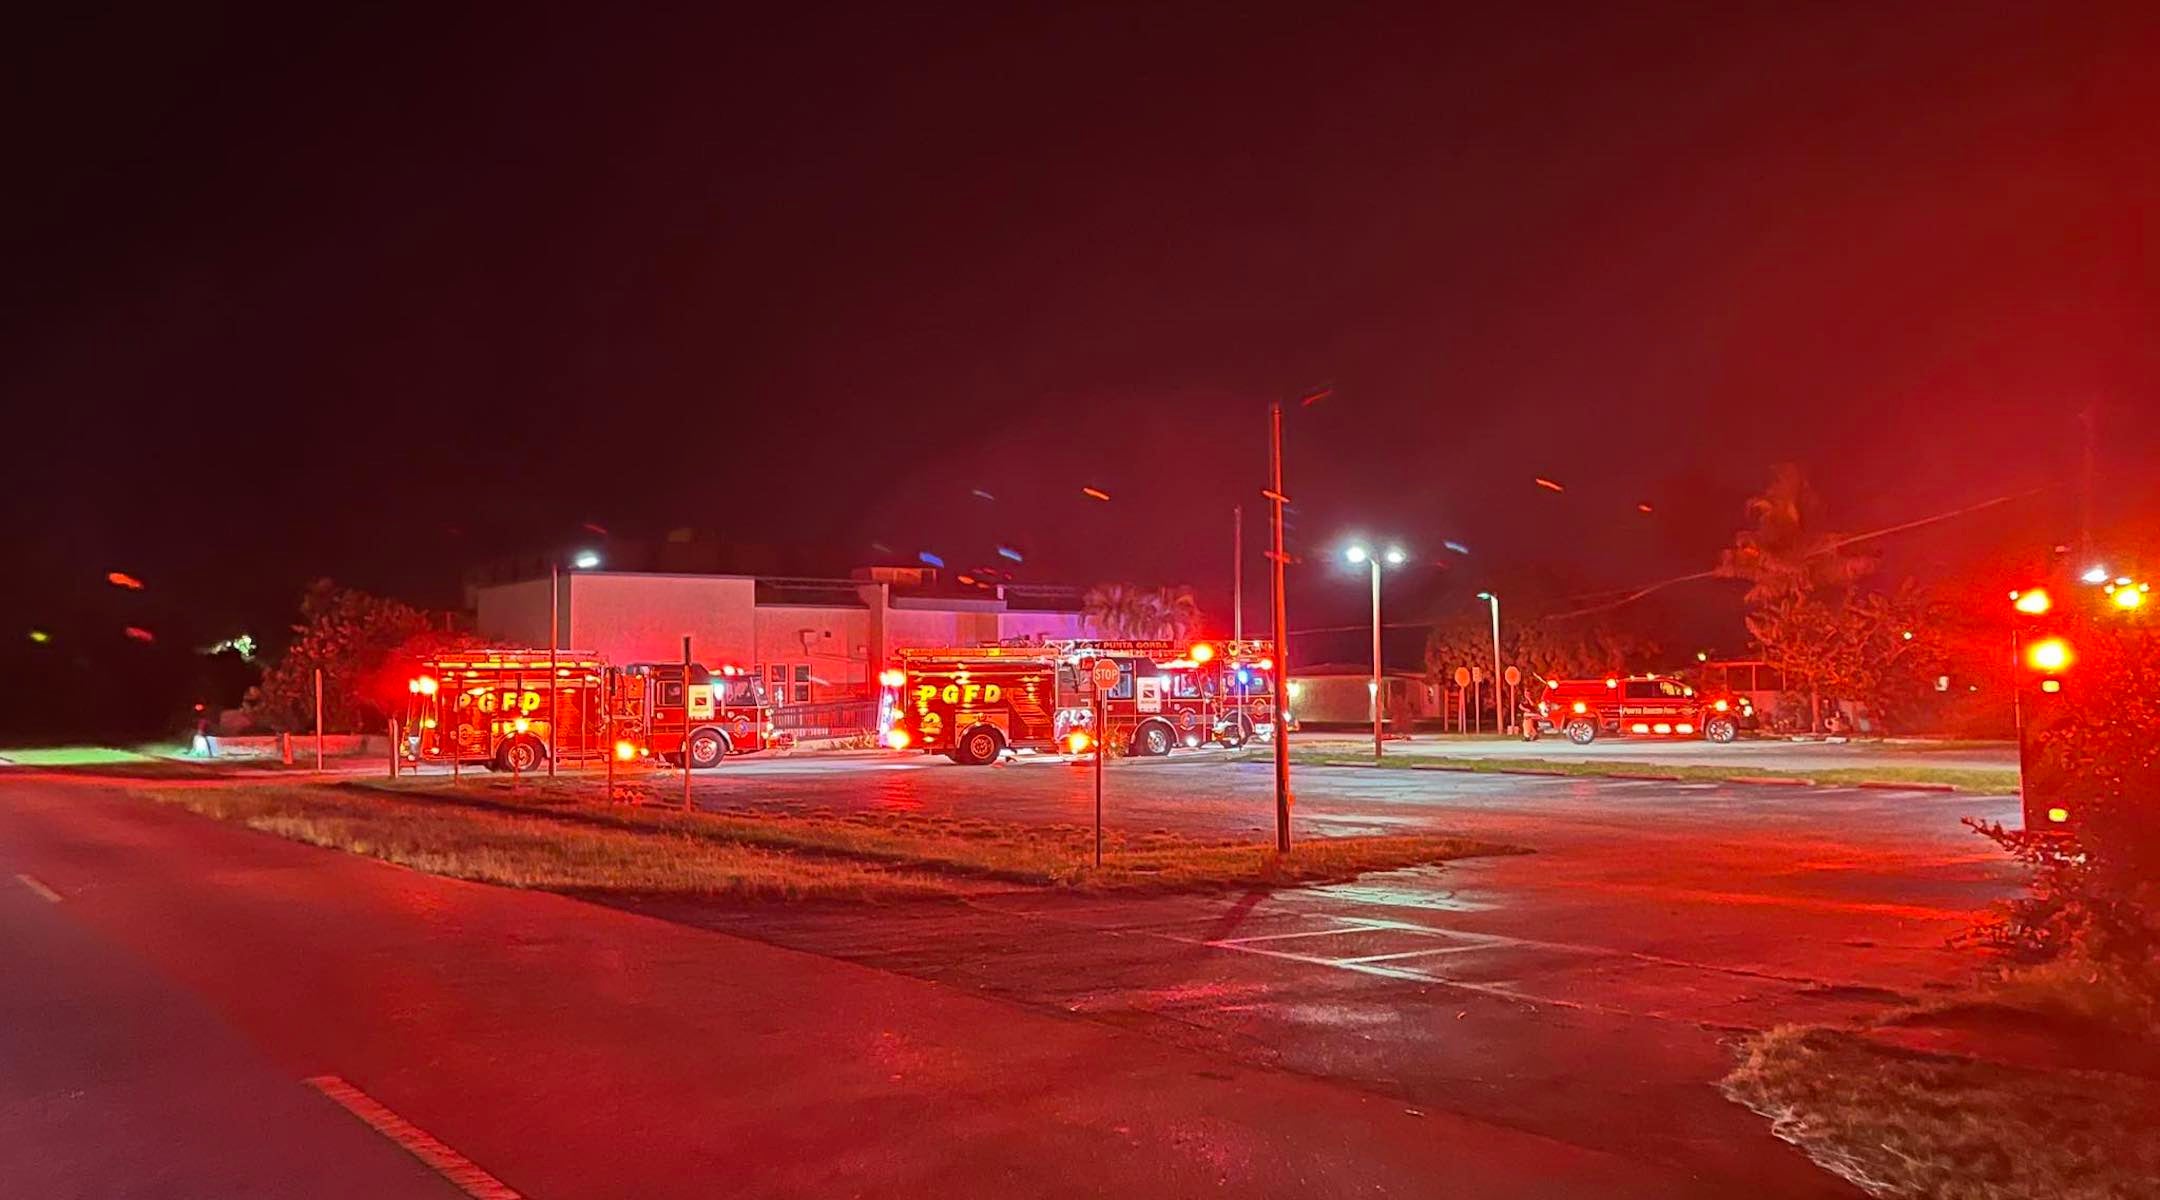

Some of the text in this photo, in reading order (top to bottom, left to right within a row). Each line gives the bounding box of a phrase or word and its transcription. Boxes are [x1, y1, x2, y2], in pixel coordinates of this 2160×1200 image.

[1095, 668, 1118, 680] STOP
[453, 692, 541, 713] PGFD
[918, 684, 1001, 704] PGFD
